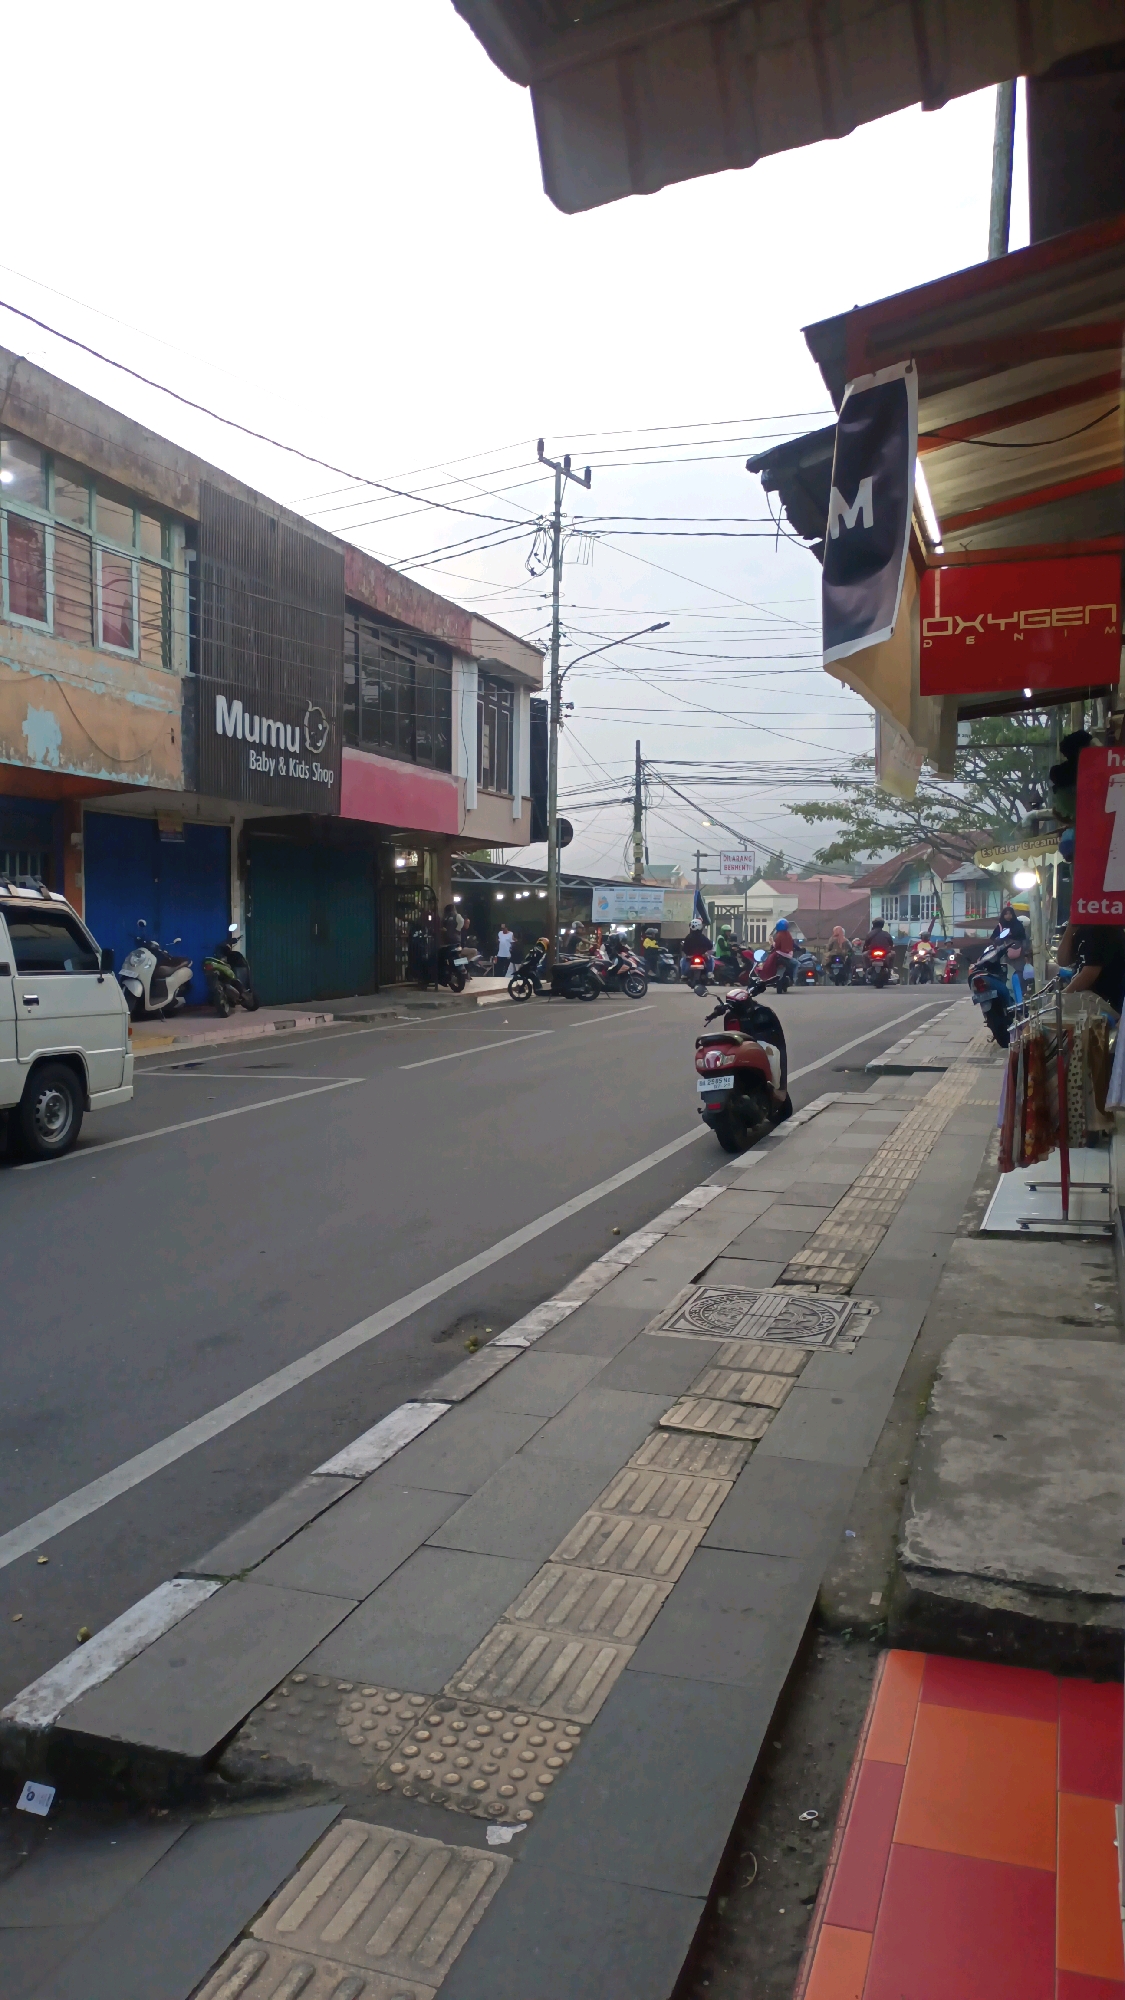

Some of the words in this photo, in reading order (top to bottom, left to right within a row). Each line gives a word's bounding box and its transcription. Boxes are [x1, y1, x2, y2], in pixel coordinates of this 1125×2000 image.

[830, 476, 874, 539] M
[922, 624, 1118, 648] DENIM
[215, 694, 300, 754] Mumu
[249, 750, 276, 776] Baby
[278, 756, 287, 776] &
[289, 757, 310, 780] Kids
[312, 762, 334, 788] Shop
[1107, 749, 1125, 767] h
[981, 848, 993, 858] Es
[995, 844, 1020, 856] Teler
[1077, 898, 1123, 915] teta
